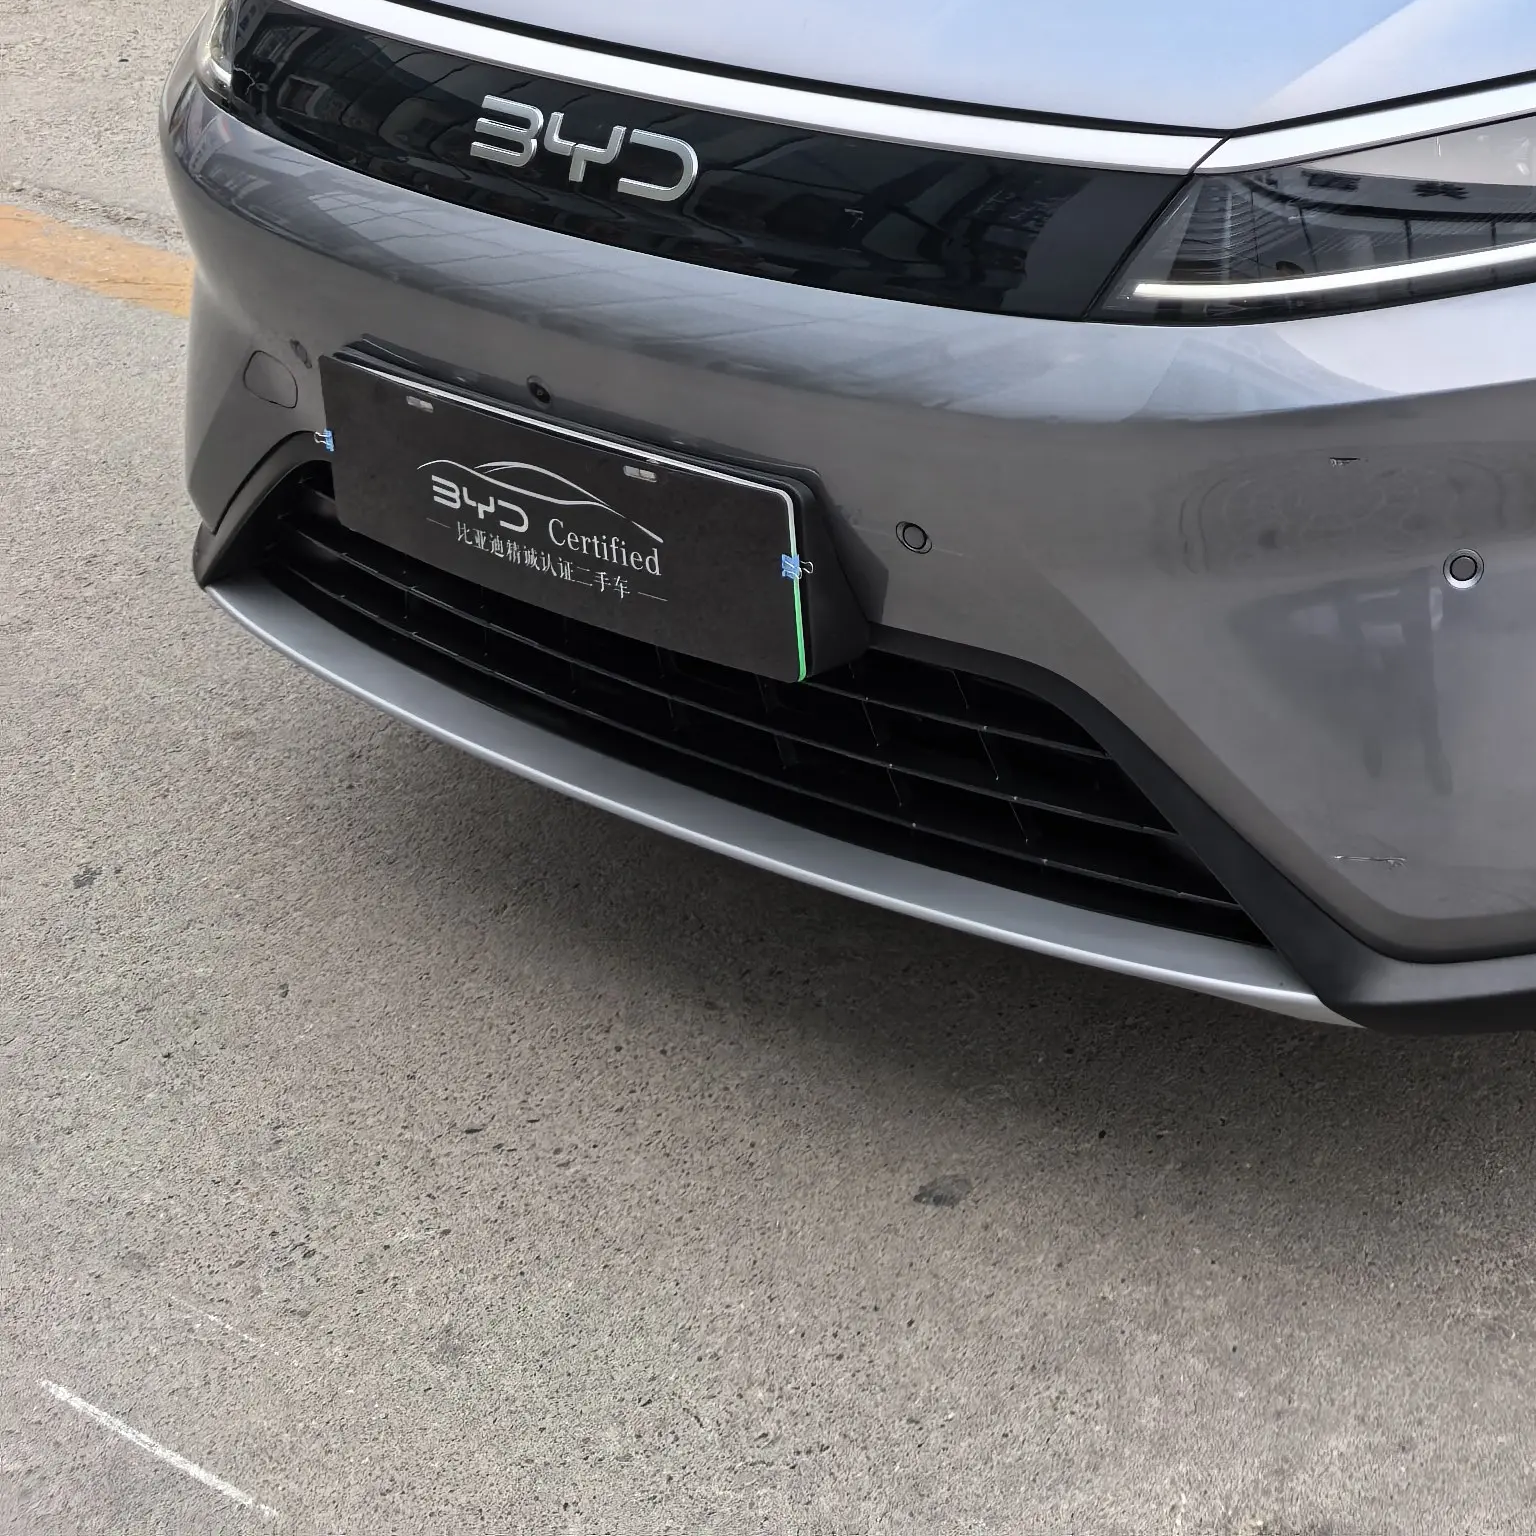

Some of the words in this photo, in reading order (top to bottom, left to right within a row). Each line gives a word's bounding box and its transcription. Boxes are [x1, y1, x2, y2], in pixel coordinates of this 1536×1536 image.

[470, 94, 699, 202] BYD
[432, 474, 529, 533] BYD
[548, 518, 662, 576] Certified
[457, 521, 631, 599] 比亚迪精诚认证二手车
